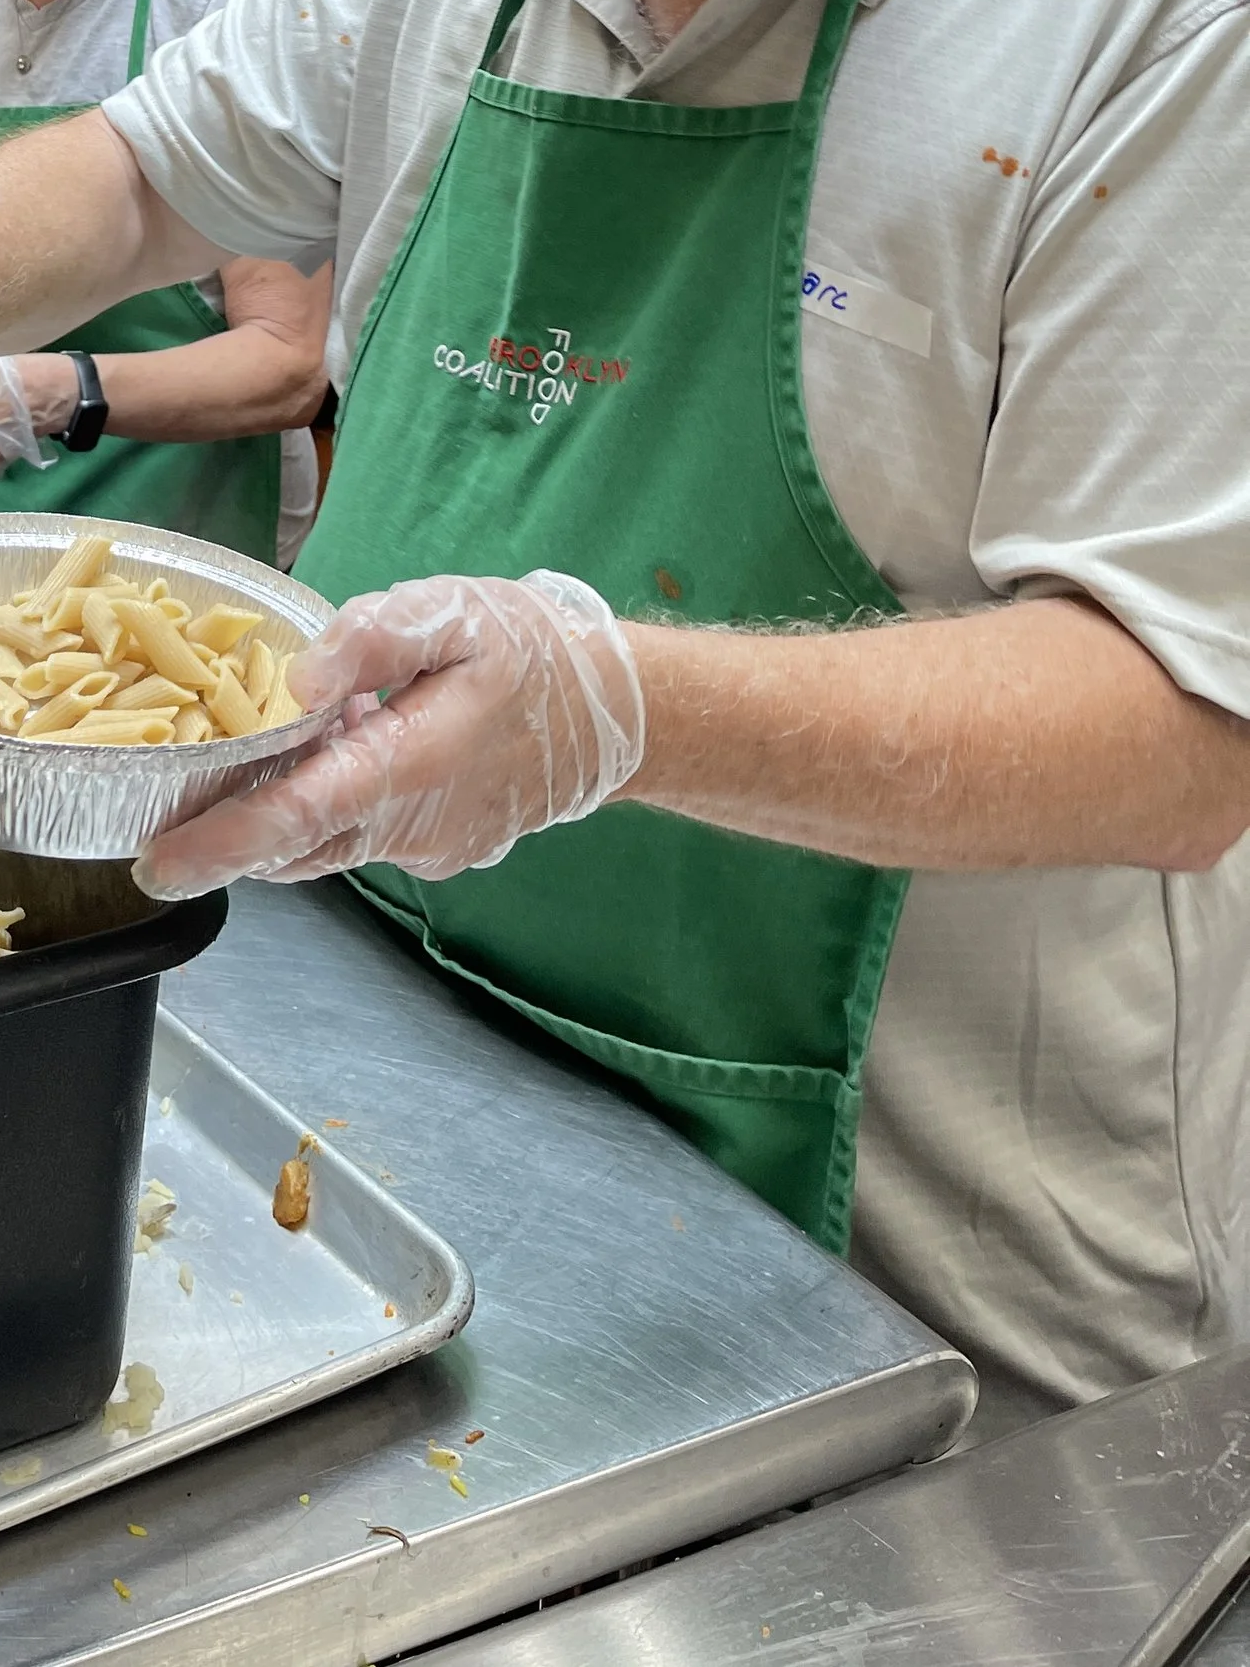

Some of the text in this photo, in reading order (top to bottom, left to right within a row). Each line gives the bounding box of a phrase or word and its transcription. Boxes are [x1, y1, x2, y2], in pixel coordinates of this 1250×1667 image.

[802, 271, 848, 311] arc
[434, 344, 578, 406] COALITION
[489, 336, 633, 384] BROOKLYN
